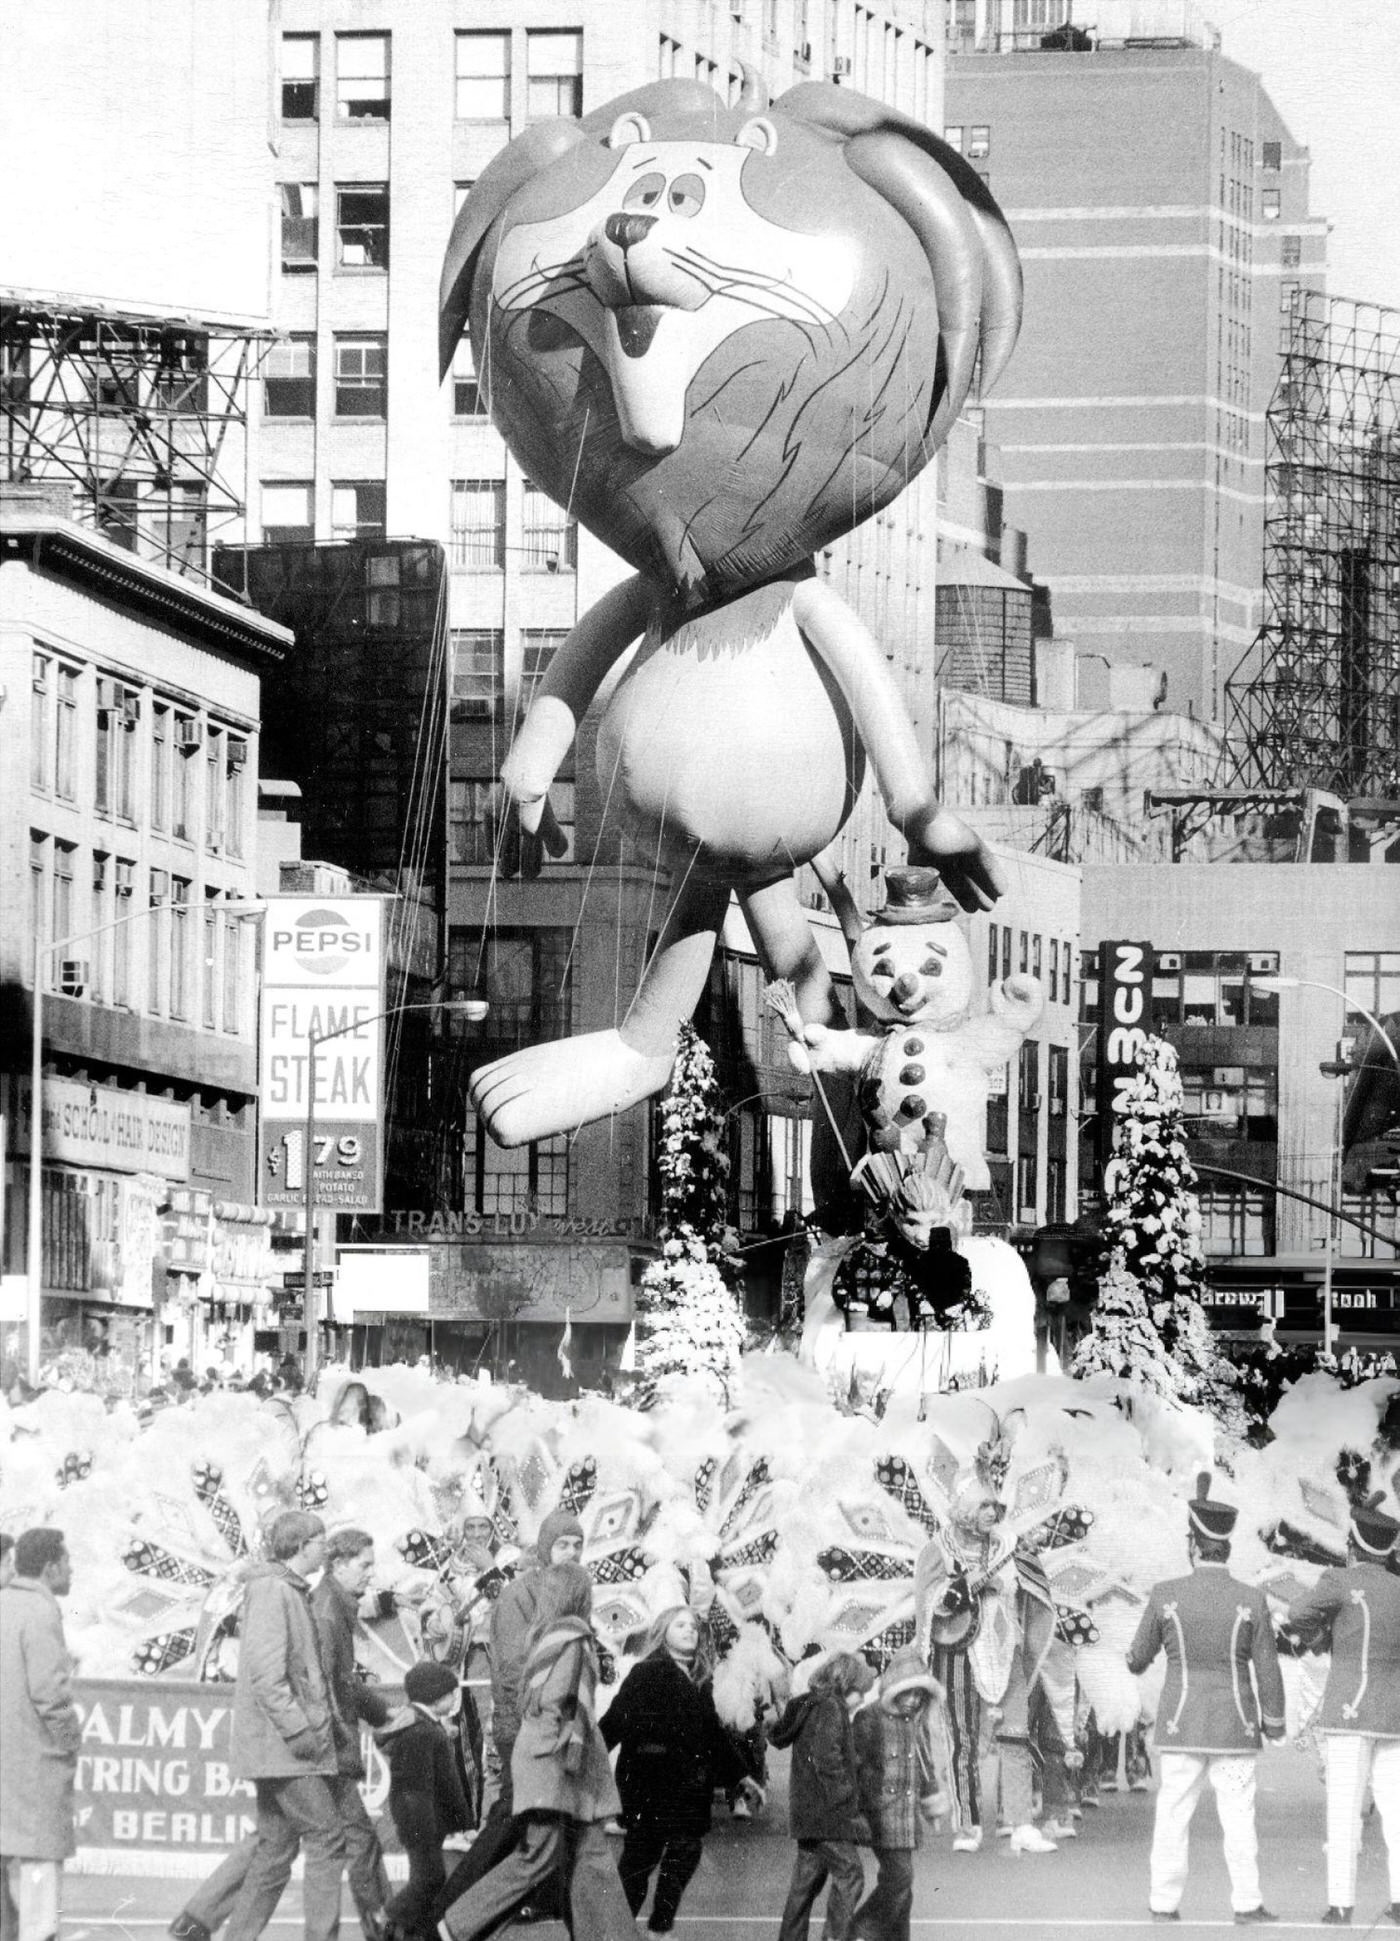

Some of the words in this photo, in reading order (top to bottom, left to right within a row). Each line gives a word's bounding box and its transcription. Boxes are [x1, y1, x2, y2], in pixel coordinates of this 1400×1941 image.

[272, 930, 372, 952] PEPSI
[271, 1004, 371, 1041] FLAME
[270, 1055, 372, 1104] STEAK
[267, 1193, 299, 1204] GARLIC
[319, 1182, 356, 1194] POTATO
[72, 1702, 235, 1750] ALMY
[73, 1756, 191, 1797] TRING
